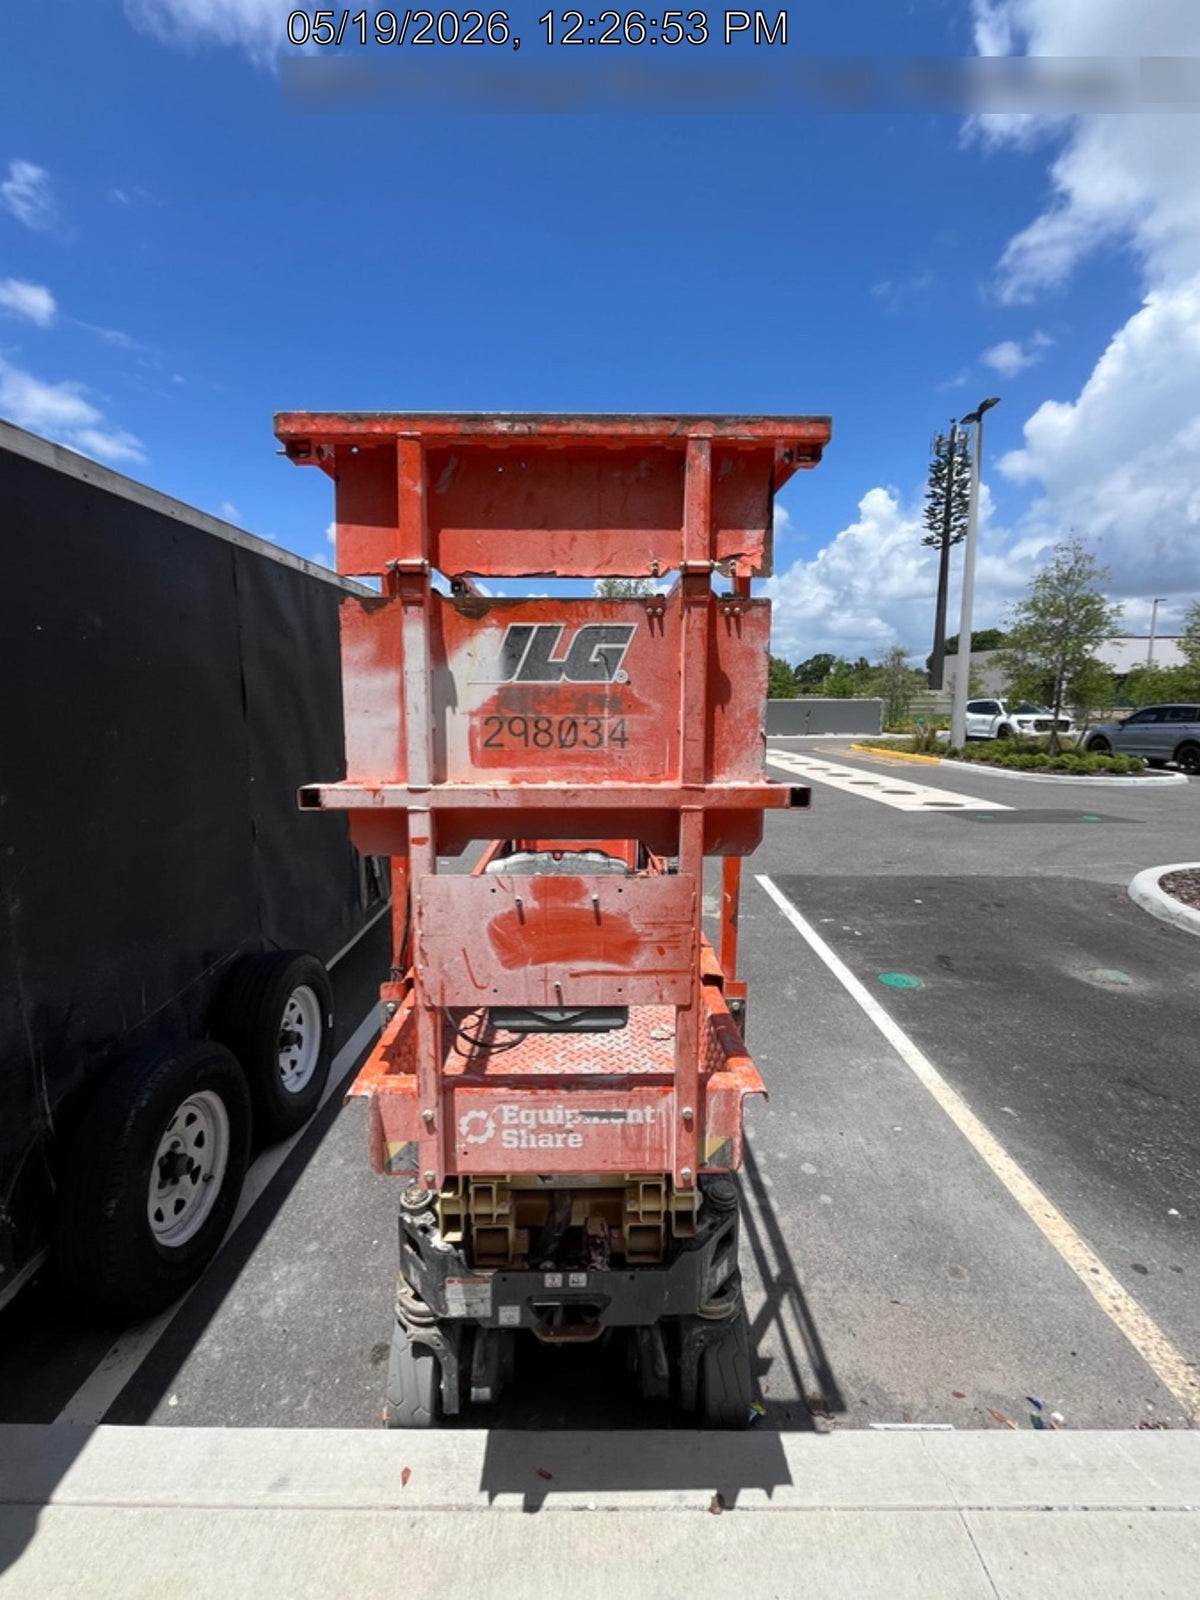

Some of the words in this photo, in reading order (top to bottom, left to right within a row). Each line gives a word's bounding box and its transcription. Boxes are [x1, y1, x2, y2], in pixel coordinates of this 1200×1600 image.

[490, 622, 638, 684] JLG
[483, 715, 629, 749] 298034
[501, 1128, 584, 1149] Share
